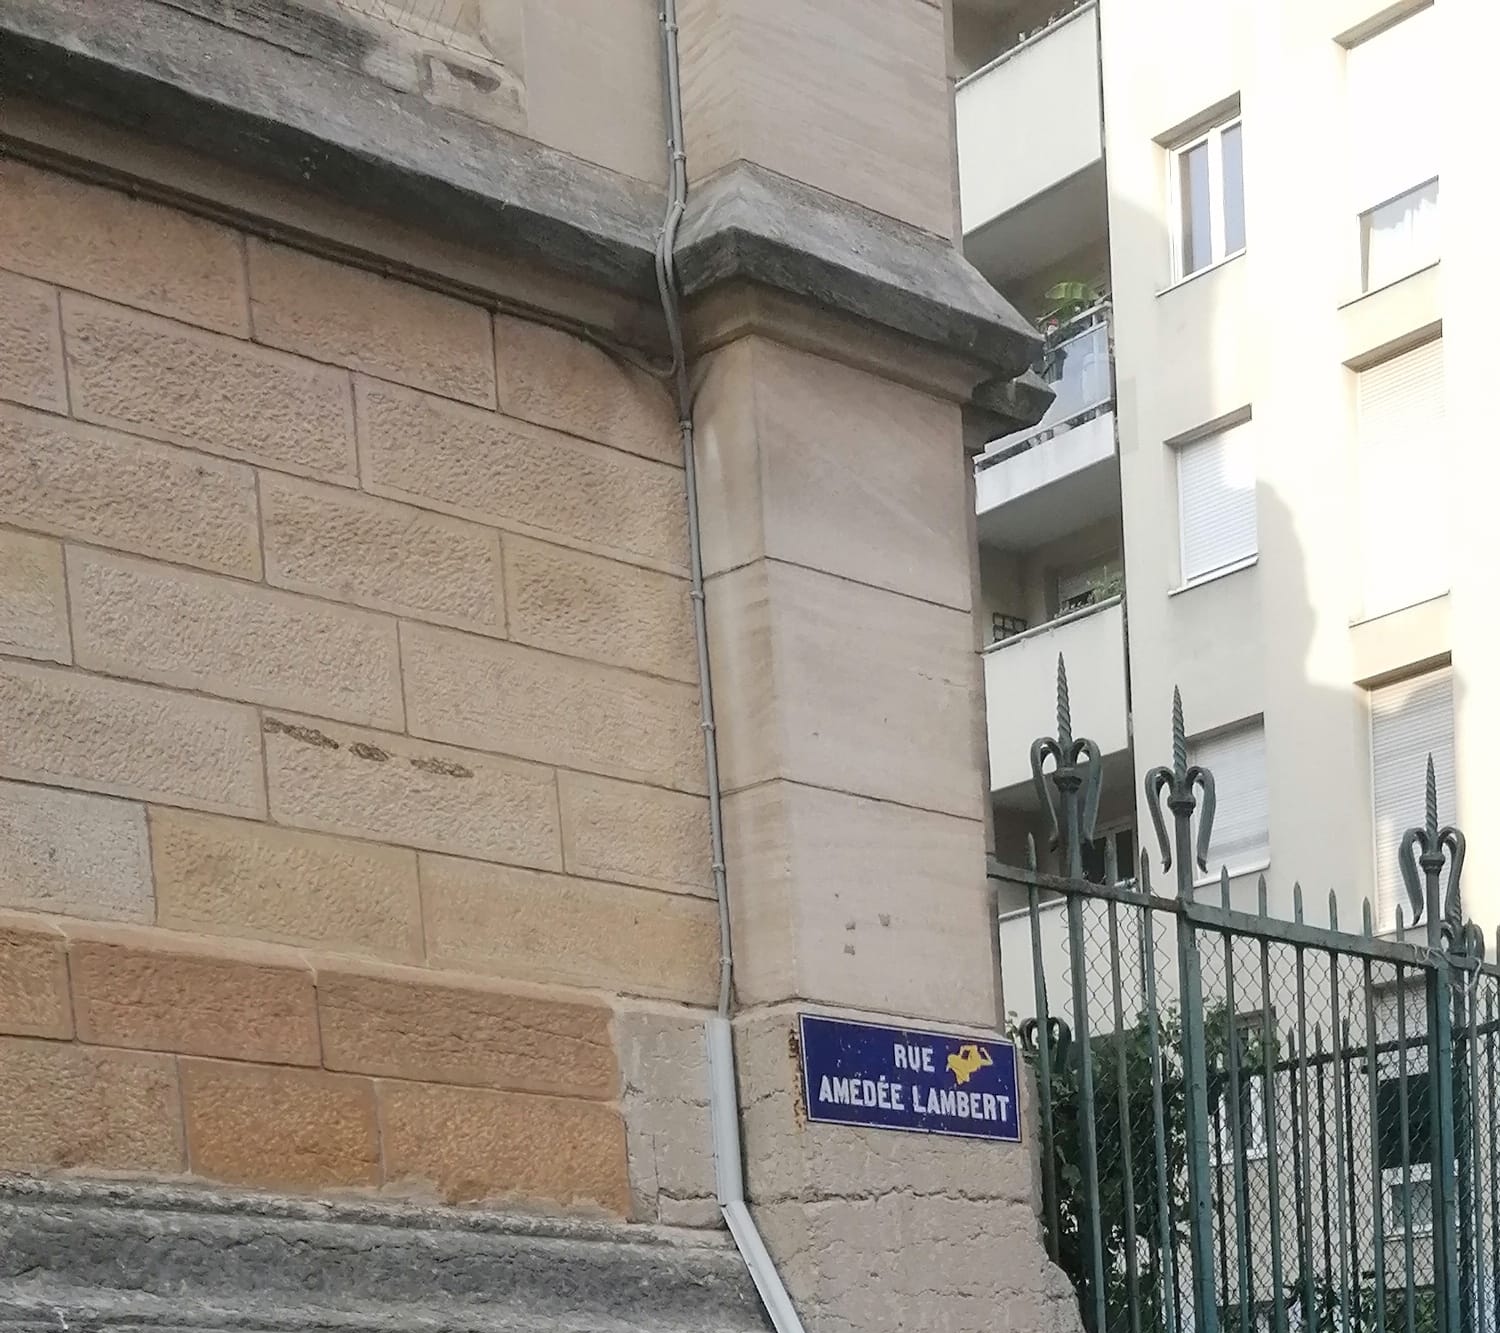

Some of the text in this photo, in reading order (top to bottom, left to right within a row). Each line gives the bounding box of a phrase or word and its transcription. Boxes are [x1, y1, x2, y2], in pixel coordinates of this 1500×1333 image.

[893, 1043, 935, 1073] RUE
[819, 1075, 1010, 1122] AMEDÉE LAMBERT
